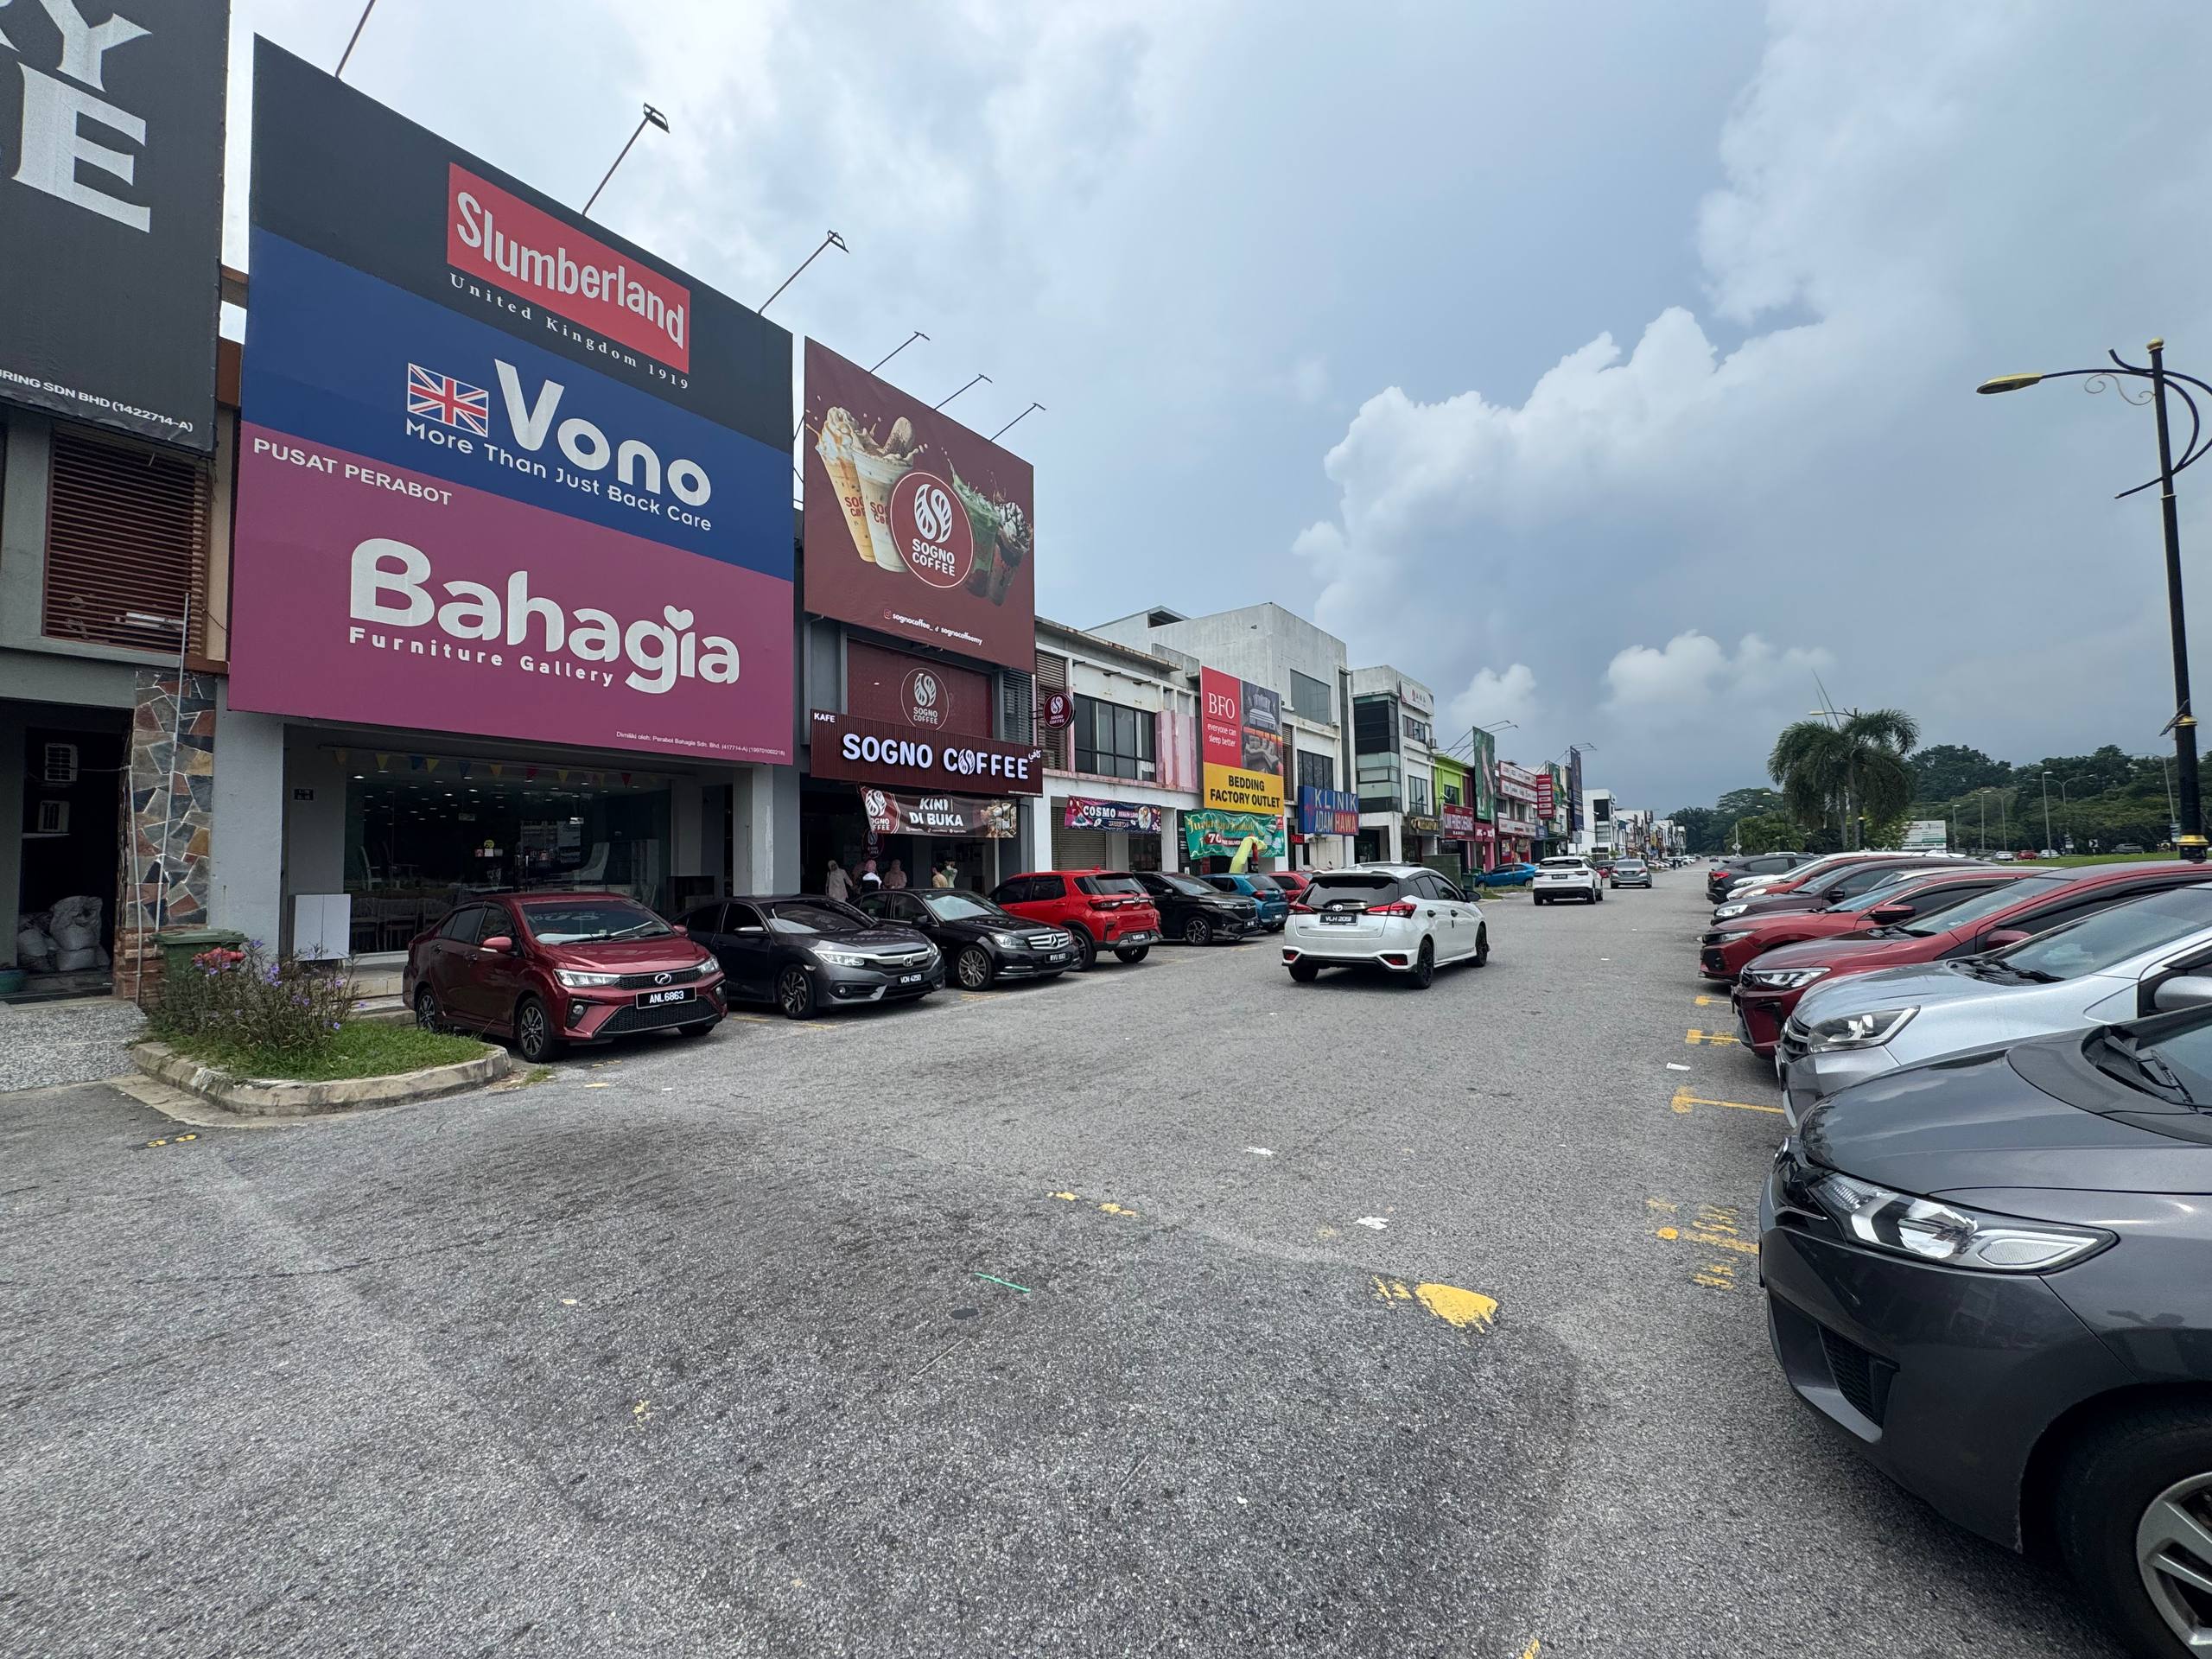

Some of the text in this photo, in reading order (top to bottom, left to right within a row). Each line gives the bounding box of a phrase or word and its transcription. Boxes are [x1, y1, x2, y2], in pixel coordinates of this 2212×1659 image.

[456, 192, 683, 349] Slumberland
[450, 274, 689, 390] United Kingdom 1919
[43, 383, 76, 398] SDN
[79, 392, 110, 408] BHD
[112, 401, 193, 432] (1422714-A)
[494, 359, 712, 506] Vono
[253, 437, 453, 506] PUSAT PERABOT
[407, 418, 712, 531] More Than Just Back Care
[912, 538, 955, 564] SOGNO
[912, 552, 956, 577] COFFEE
[350, 538, 740, 694] Bahagia
[349, 627, 614, 688] Furniture Gallery
[913, 707, 938, 718] SOGNO
[1208, 692, 1235, 719] BFO
[814, 712, 836, 723] KAFE
[913, 715, 938, 725] COFFEE
[1207, 723, 1228, 734] everyone
[842, 734, 933, 768] SOGNO
[1222, 737, 1236, 747] better
[1229, 775, 1265, 791] BEDDING
[919, 798, 949, 810] KINI
[1210, 789, 1280, 808] FACTORY OUTLET
[1314, 789, 1357, 811] KLINIK
[909, 811, 964, 827] DI BUKA
[1083, 805, 1116, 818] COSMO
[1314, 810, 1357, 833] ADAM HAWA
[650, 990, 683, 1003] ANL 6863
